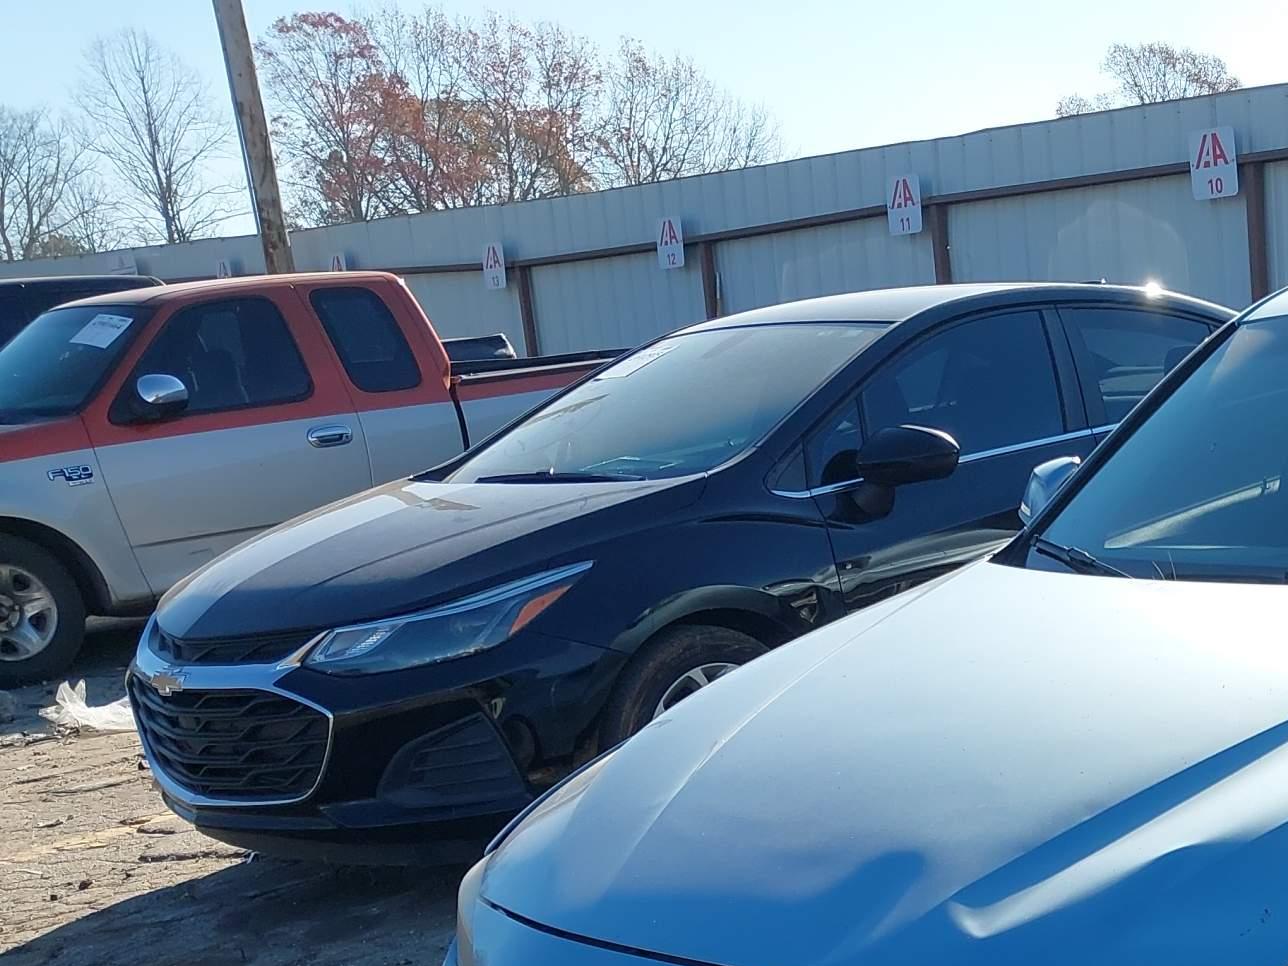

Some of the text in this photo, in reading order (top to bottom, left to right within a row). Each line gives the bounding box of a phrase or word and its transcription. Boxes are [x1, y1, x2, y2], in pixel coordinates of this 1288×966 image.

[1207, 177, 1223, 195] 10
[900, 217, 910, 231] 11
[667, 253, 676, 265] 12
